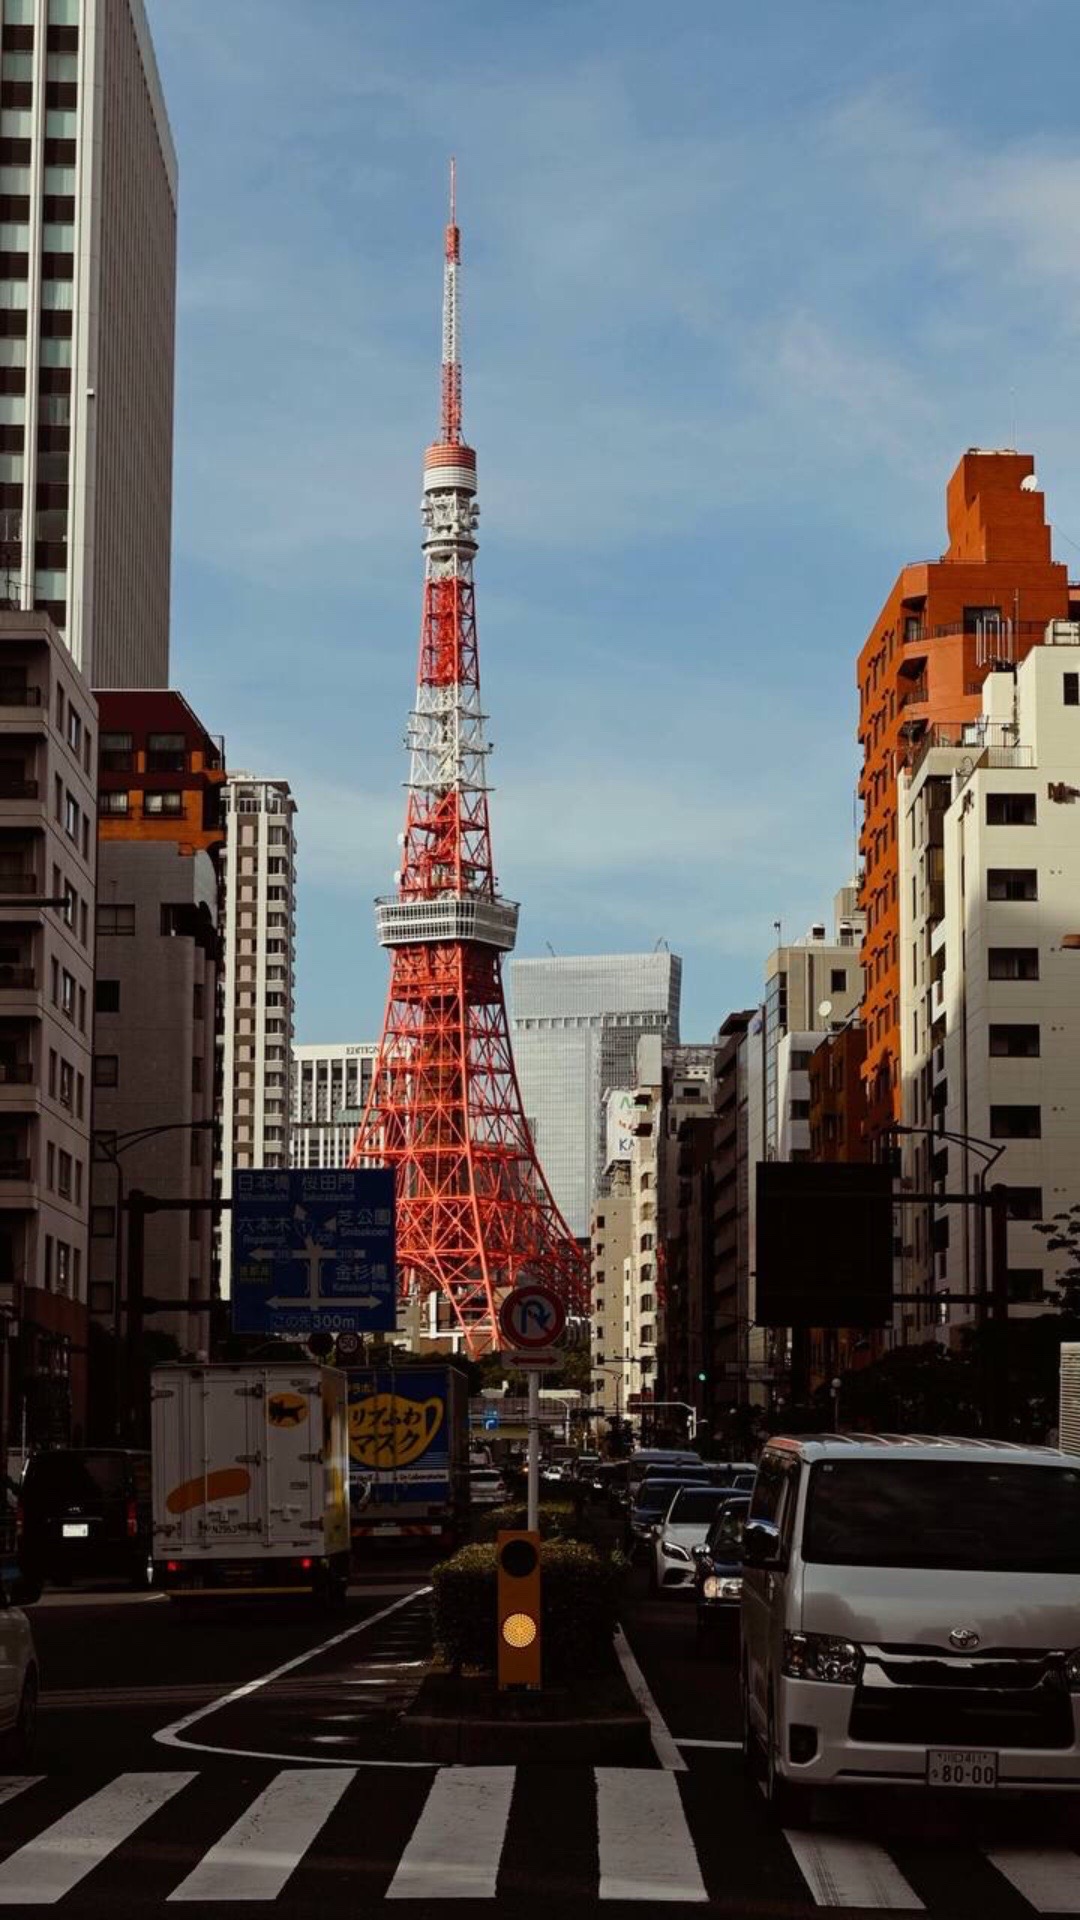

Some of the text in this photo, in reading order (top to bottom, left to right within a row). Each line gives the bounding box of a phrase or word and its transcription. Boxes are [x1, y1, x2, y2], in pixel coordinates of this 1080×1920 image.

[350, 1429, 421, 1454] マスク
[943, 1765, 994, 1784] 80-00
